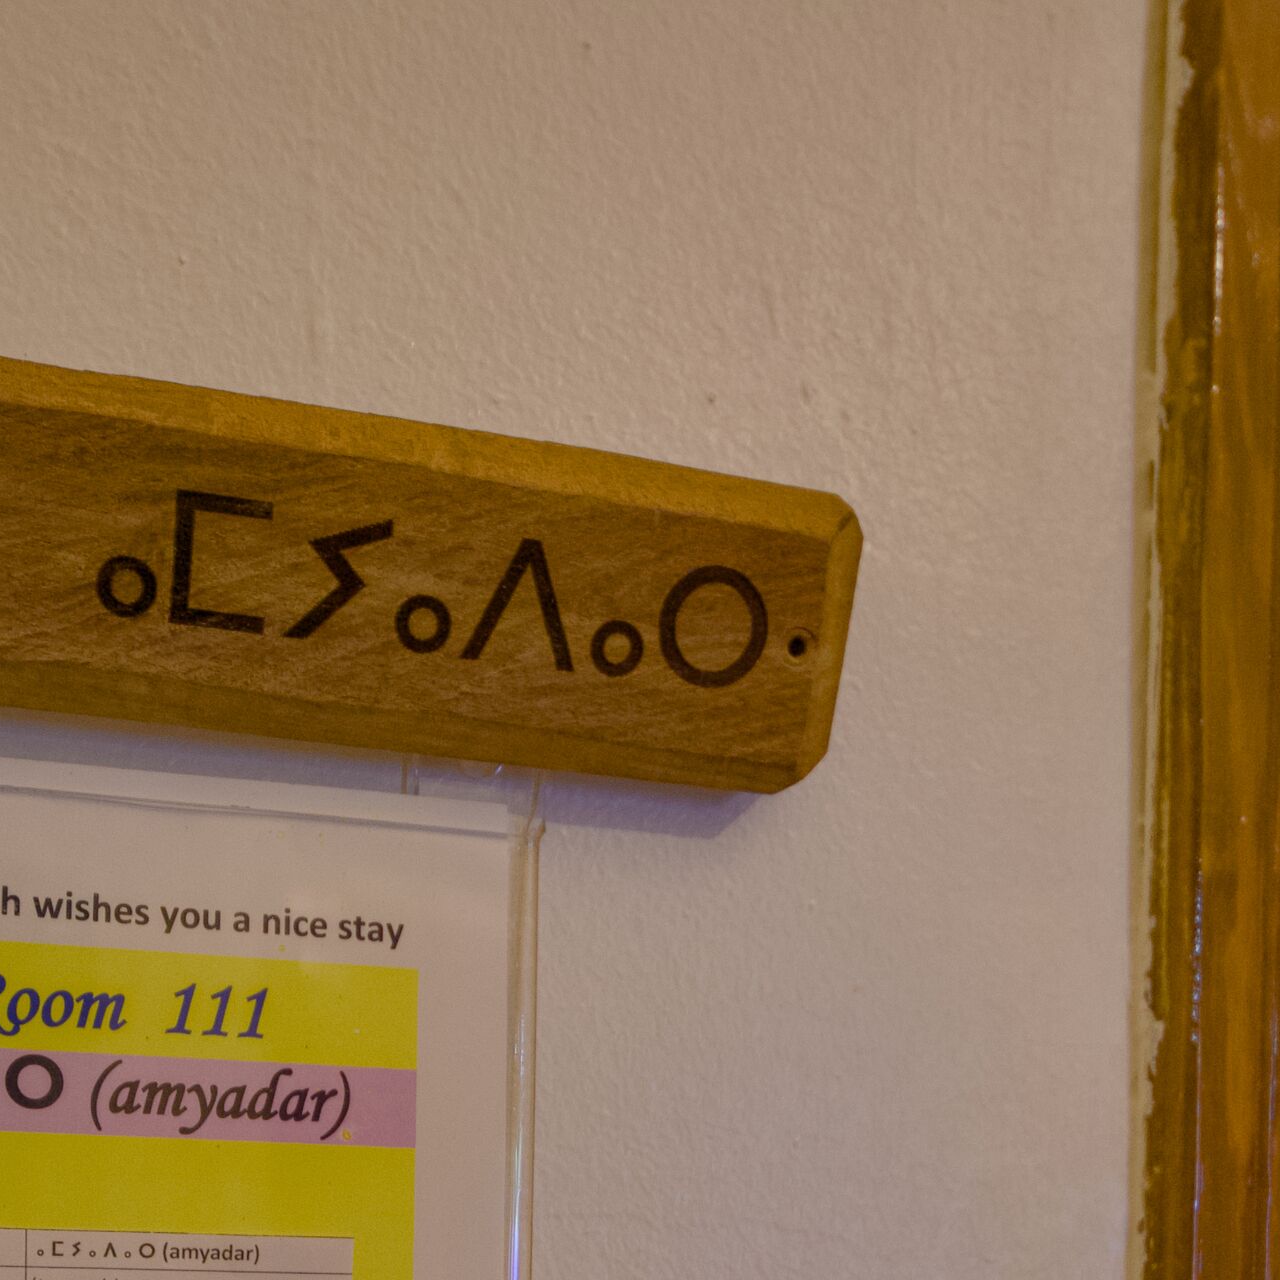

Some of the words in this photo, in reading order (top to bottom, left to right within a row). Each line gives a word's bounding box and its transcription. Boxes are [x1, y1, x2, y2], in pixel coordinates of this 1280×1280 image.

[33, 891, 149, 925] wishes
[161, 906, 220, 934] you
[233, 912, 249, 932] a
[263, 908, 327, 938] nice
[339, 917, 404, 949] stay
[165, 983, 270, 1040] 111
[89, 1059, 352, 1141] (amyadar)
[163, 1242, 259, 1264] (amyadar)
